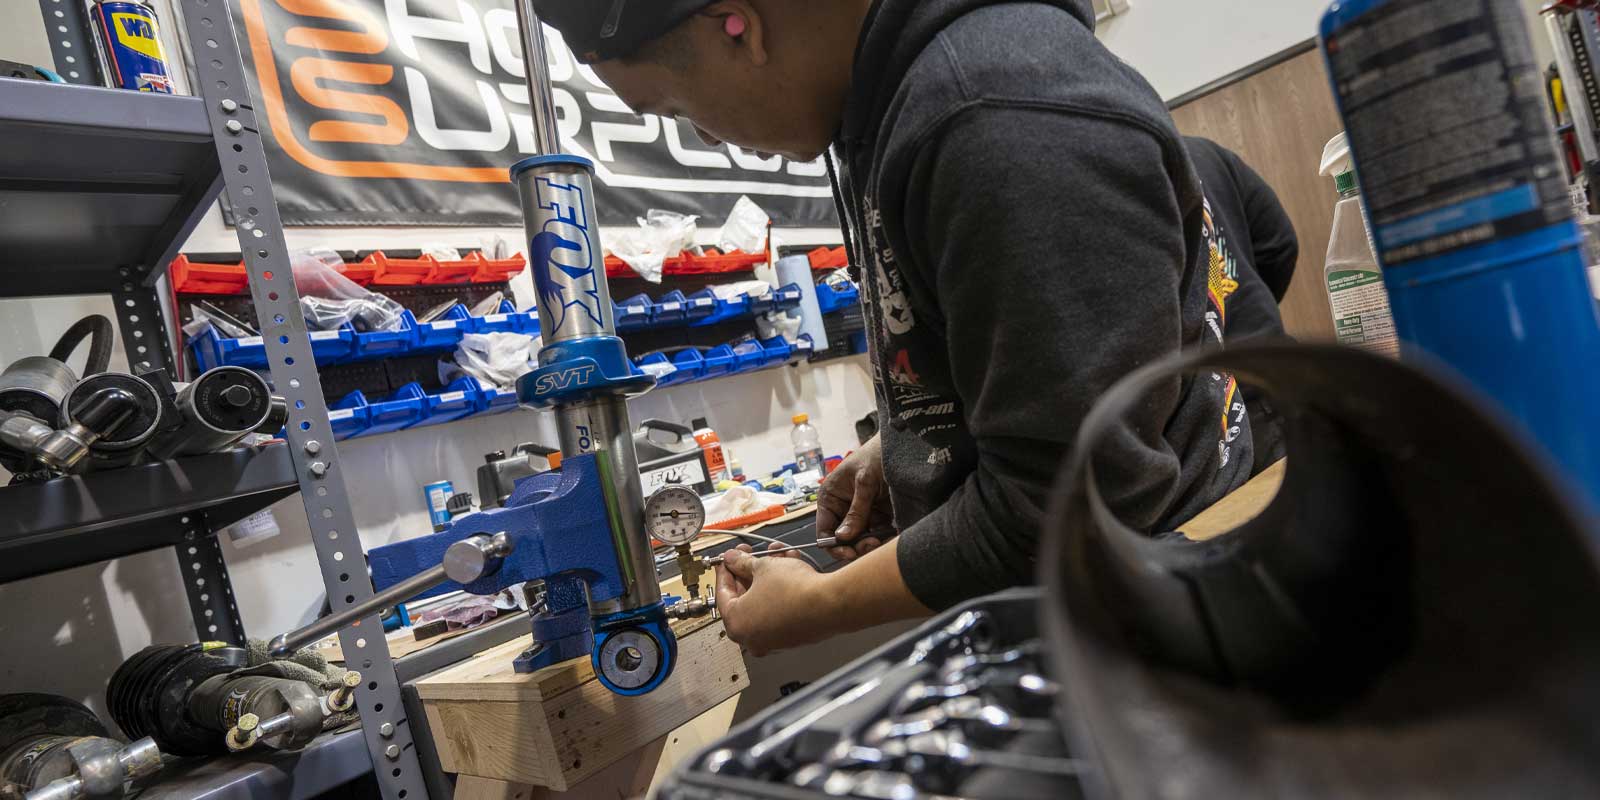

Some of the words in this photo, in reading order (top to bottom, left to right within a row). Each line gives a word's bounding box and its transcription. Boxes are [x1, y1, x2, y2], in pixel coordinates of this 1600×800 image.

[531, 176, 604, 336] FOX
[534, 364, 596, 396] SVT
[898, 402, 955, 420] an-am
[575, 425, 591, 453] FO
[650, 465, 687, 487] FOX
